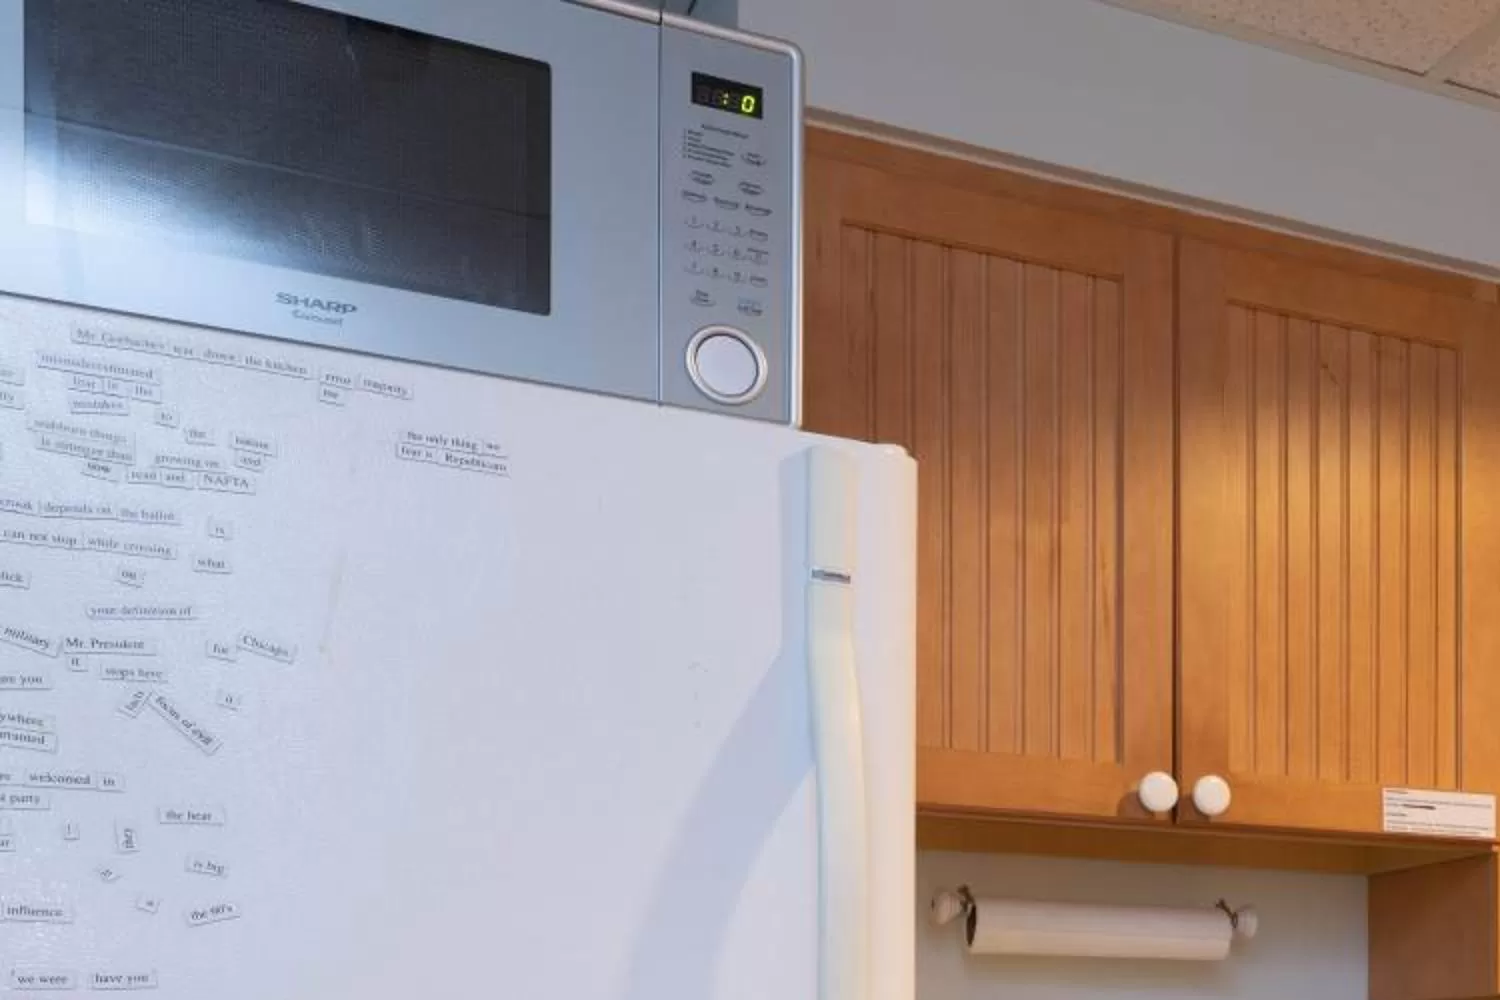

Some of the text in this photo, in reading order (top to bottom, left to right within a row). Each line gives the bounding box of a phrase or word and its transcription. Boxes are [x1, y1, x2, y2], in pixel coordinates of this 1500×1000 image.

[275, 291, 358, 314] SHARP
[425, 433, 448, 447] only
[450, 436, 478, 451] thing
[204, 473, 250, 489] NAFTA
[43, 499, 94, 515] depends
[88, 535, 119, 551] while
[66, 636, 146, 650] Mr. President
[6, 900, 65, 917] influence
[16, 976, 69, 986] we were
[94, 972, 150, 989] have you
